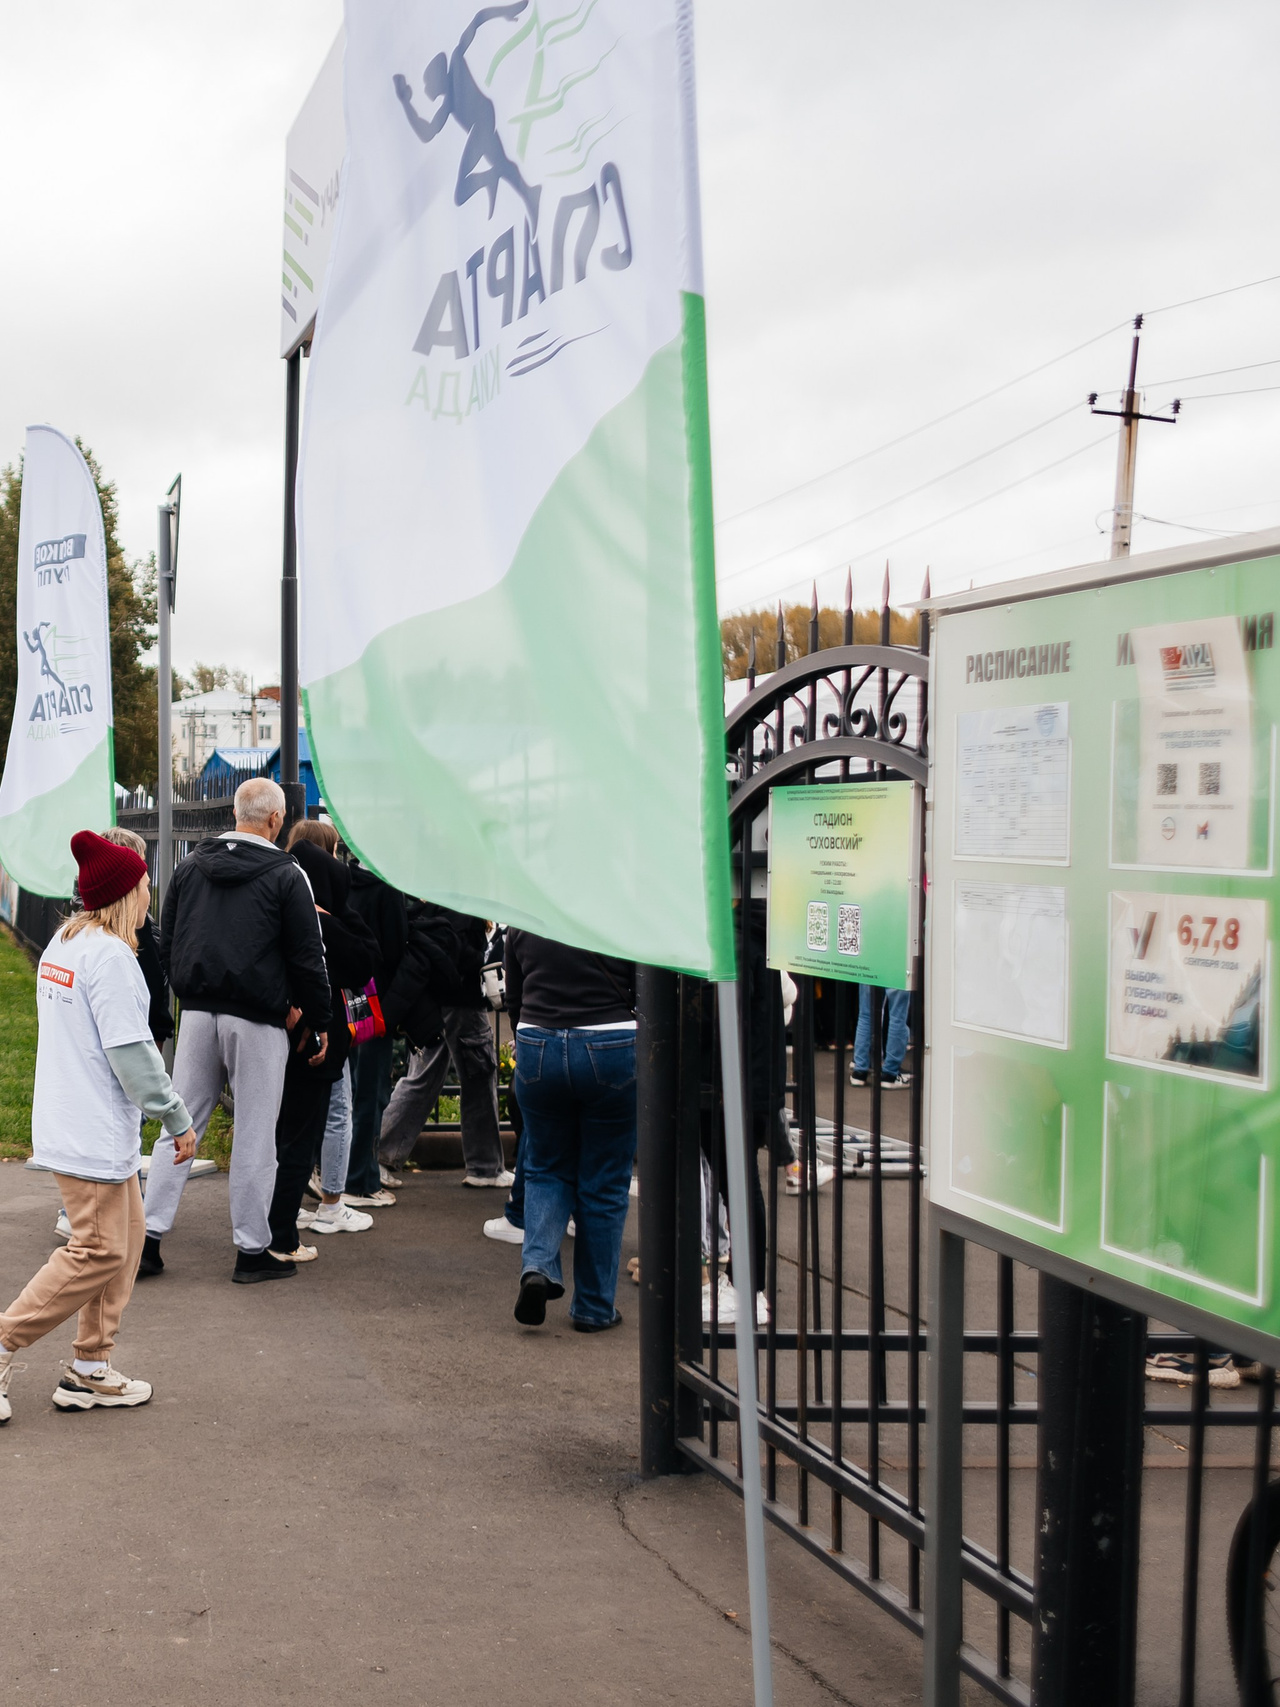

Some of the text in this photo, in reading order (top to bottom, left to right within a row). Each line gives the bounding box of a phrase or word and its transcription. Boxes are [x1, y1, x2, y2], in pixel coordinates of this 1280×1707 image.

[965, 641, 1071, 684] РАСПИСАНИЕ
[813, 813, 853, 829] СТАДИОН
[1177, 914, 1240, 956] 6,7,8
[1183, 957, 1219, 968] СЕНТЯБРЯ
